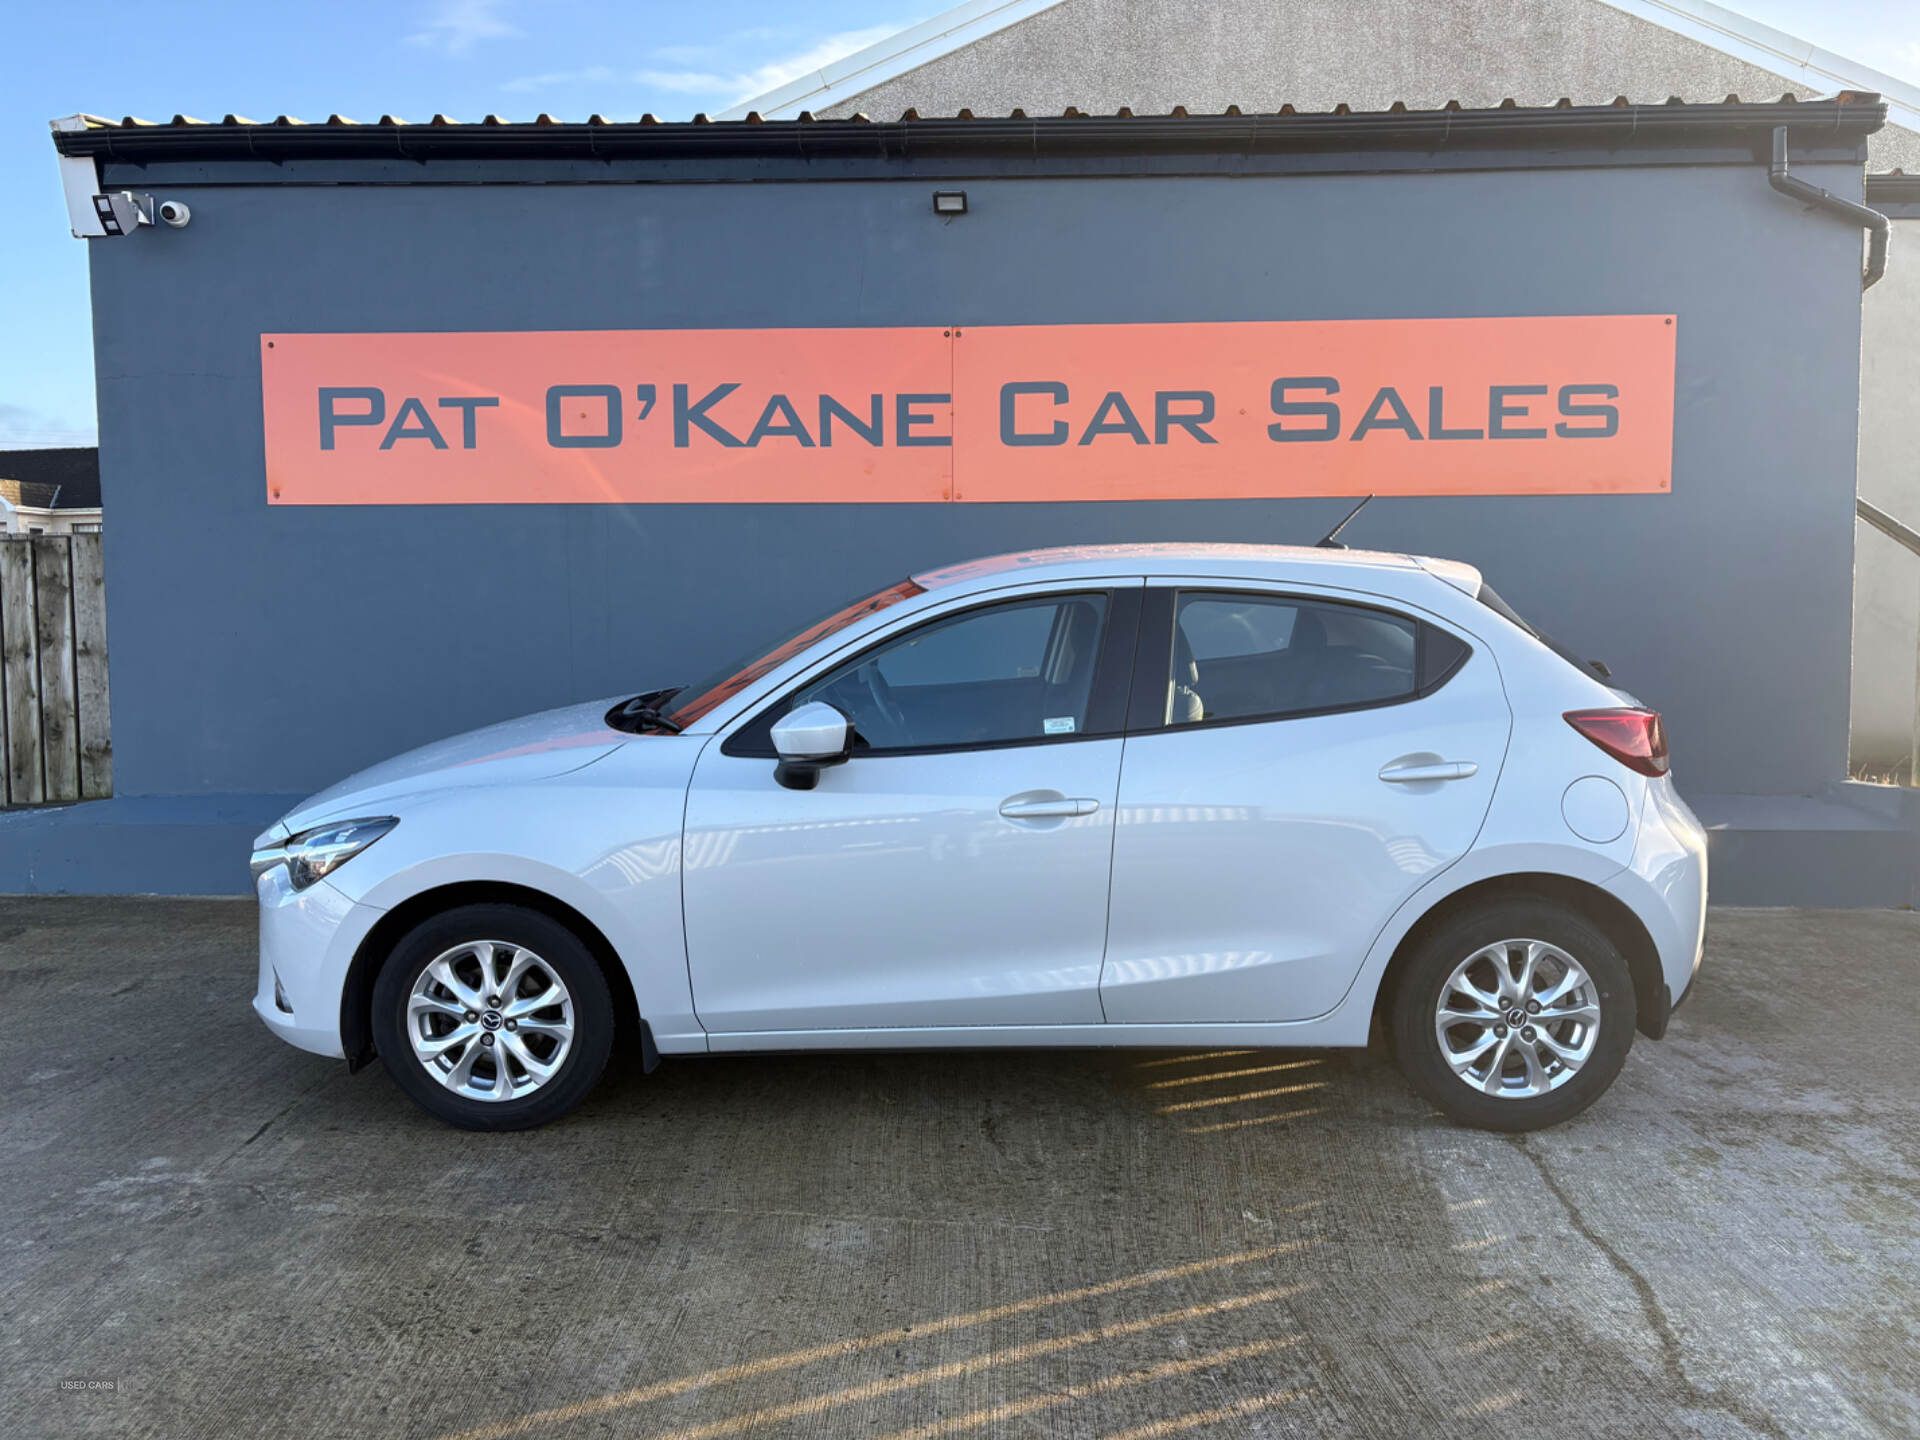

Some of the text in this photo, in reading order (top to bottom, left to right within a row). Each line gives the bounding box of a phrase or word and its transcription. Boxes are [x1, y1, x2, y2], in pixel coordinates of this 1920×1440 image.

[317, 386, 500, 451] PAT
[999, 380, 1219, 447] CAR
[1267, 376, 1620, 442] SALES
